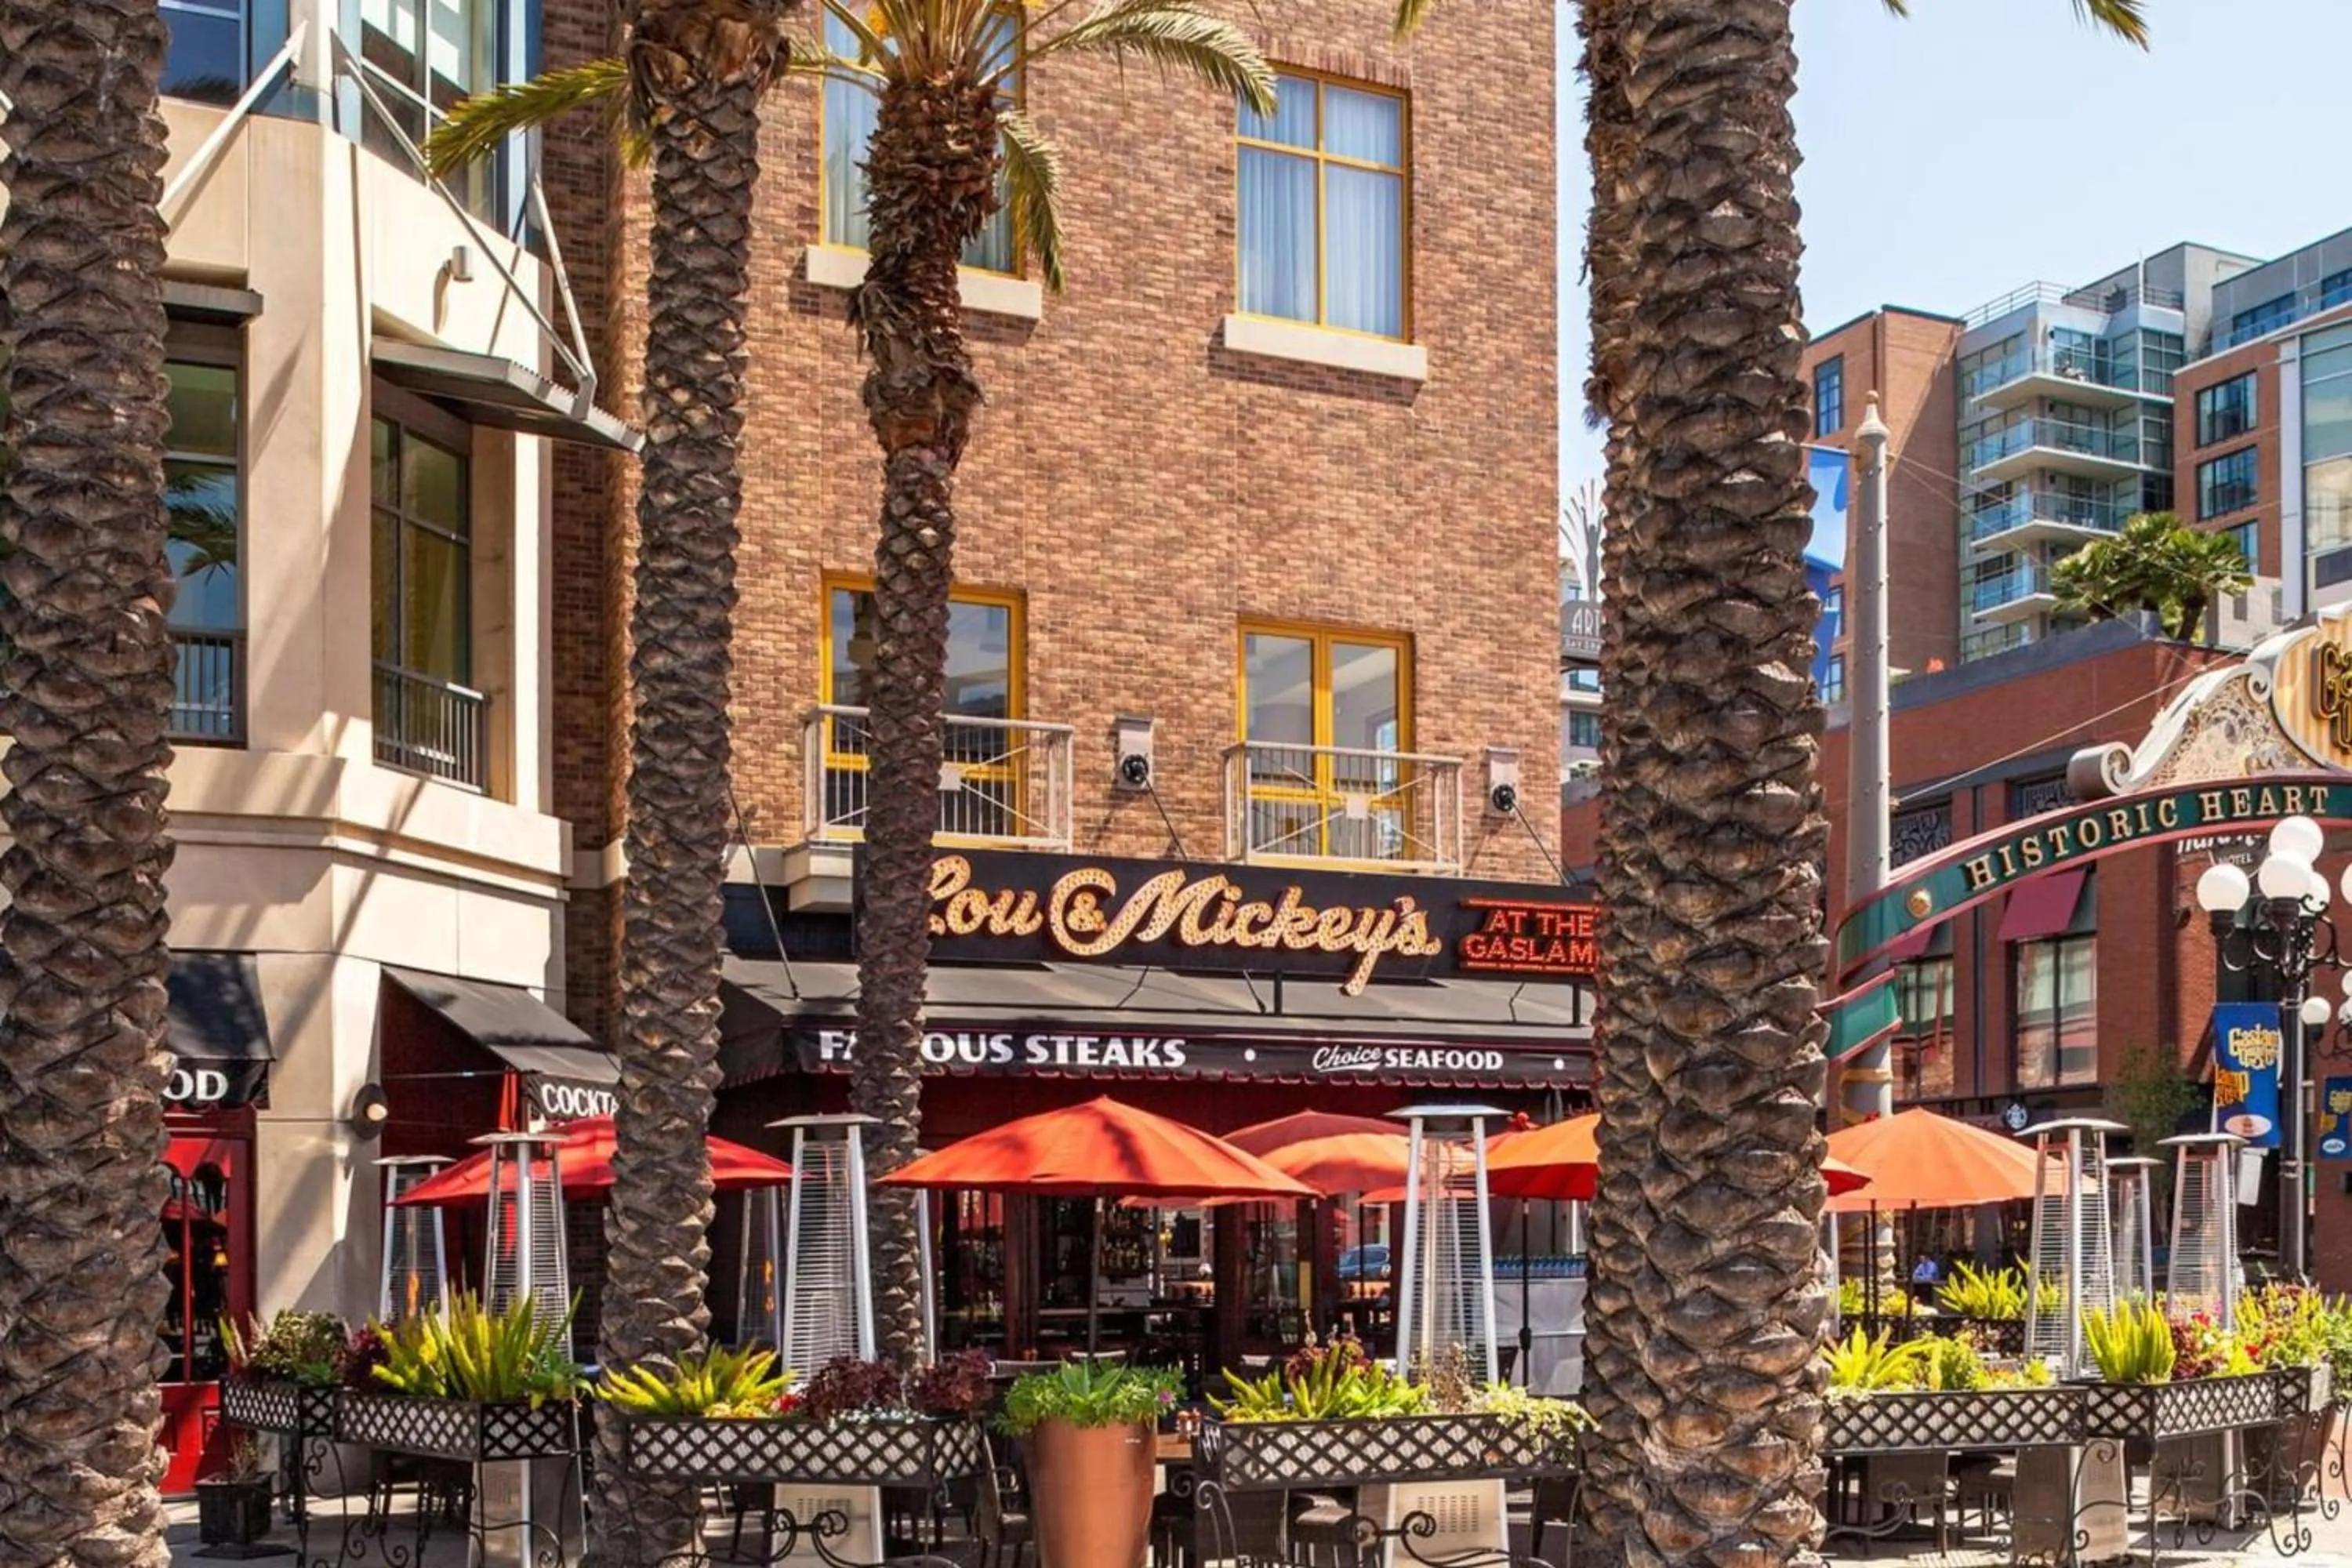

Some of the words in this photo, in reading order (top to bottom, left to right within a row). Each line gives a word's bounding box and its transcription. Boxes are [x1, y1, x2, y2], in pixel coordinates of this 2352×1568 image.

[1965, 797, 2179, 892] HISTORIC
[2199, 786, 2330, 823] HEART
[1049, 867, 1443, 996] Mickey's
[1487, 909, 1528, 934] AT
[1536, 912, 1595, 938] THE
[1465, 933, 1596, 964] GASLAM
[1025, 1034, 1186, 1068] STEAKS
[1312, 1045, 1382, 1071] Choice
[1385, 1048, 1504, 1070] SEAFOOD
